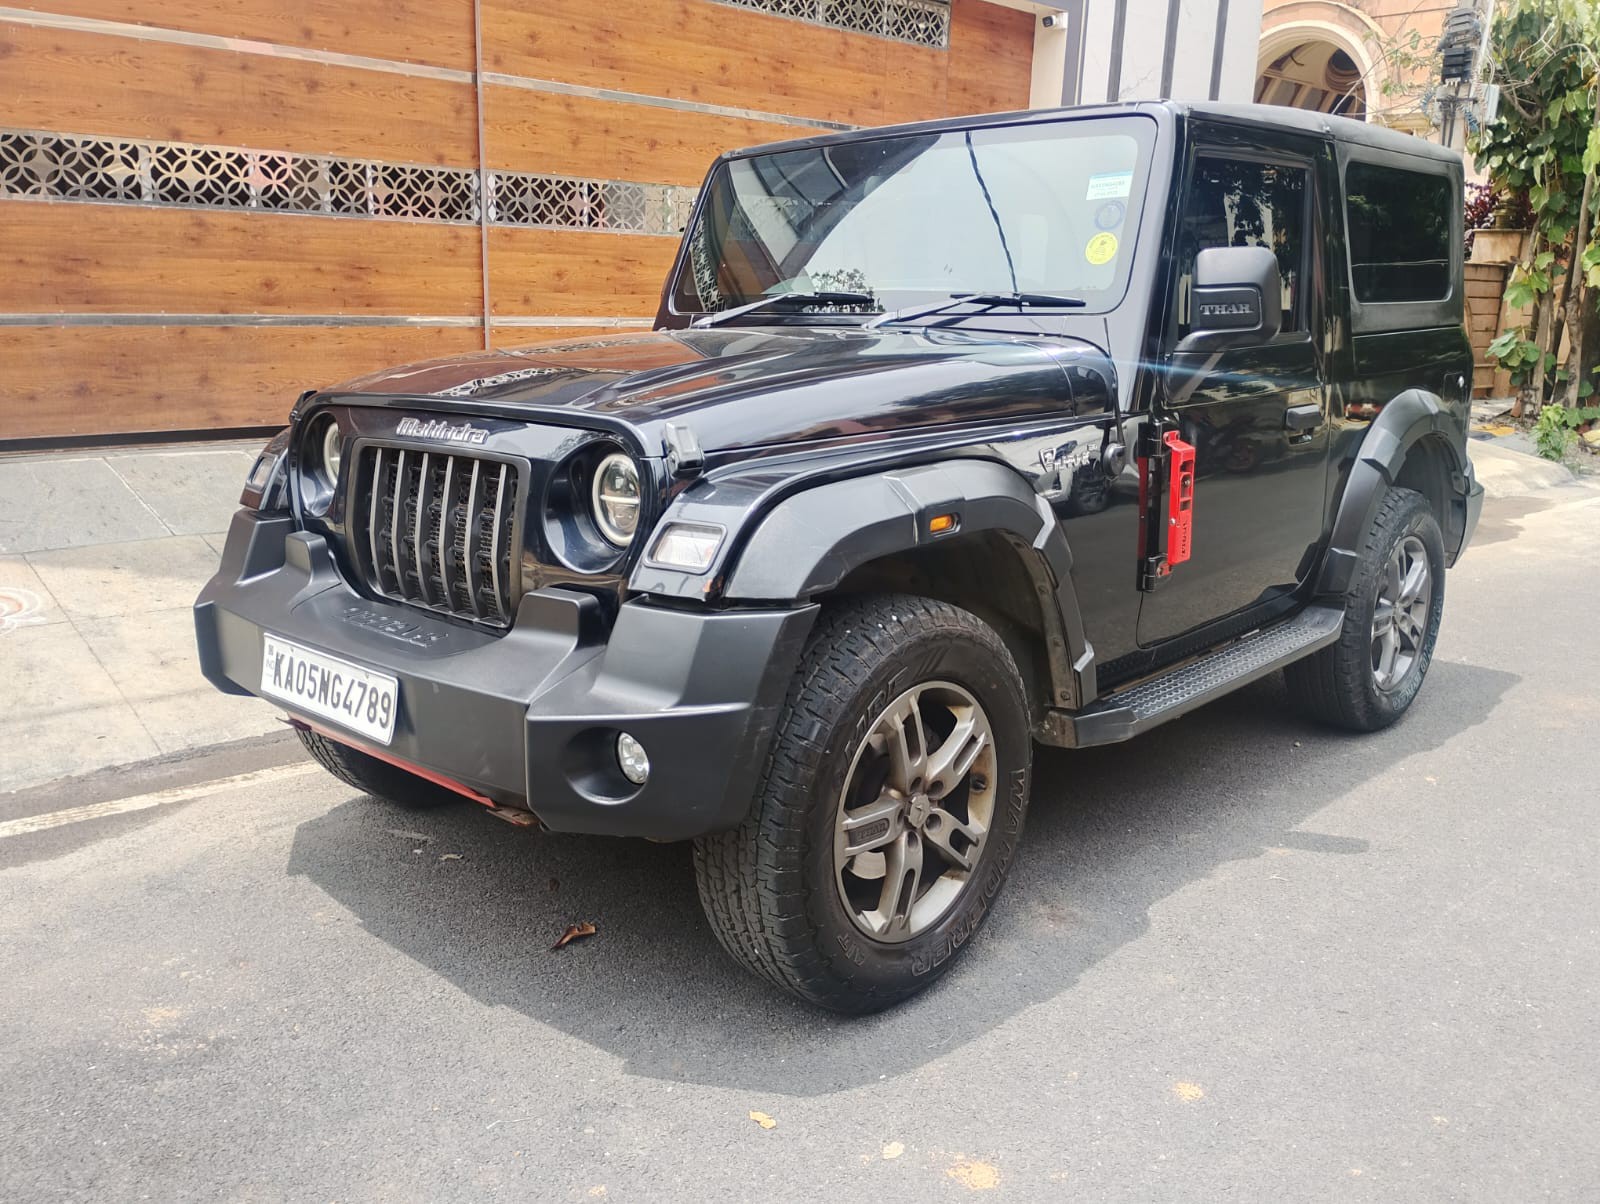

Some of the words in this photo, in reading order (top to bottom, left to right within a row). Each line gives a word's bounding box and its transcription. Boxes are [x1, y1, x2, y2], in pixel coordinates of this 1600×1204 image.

[1200, 303, 1254, 315] THAR
[396, 417, 490, 443] Mahindra
[273, 652, 391, 729] KA05NG4789
